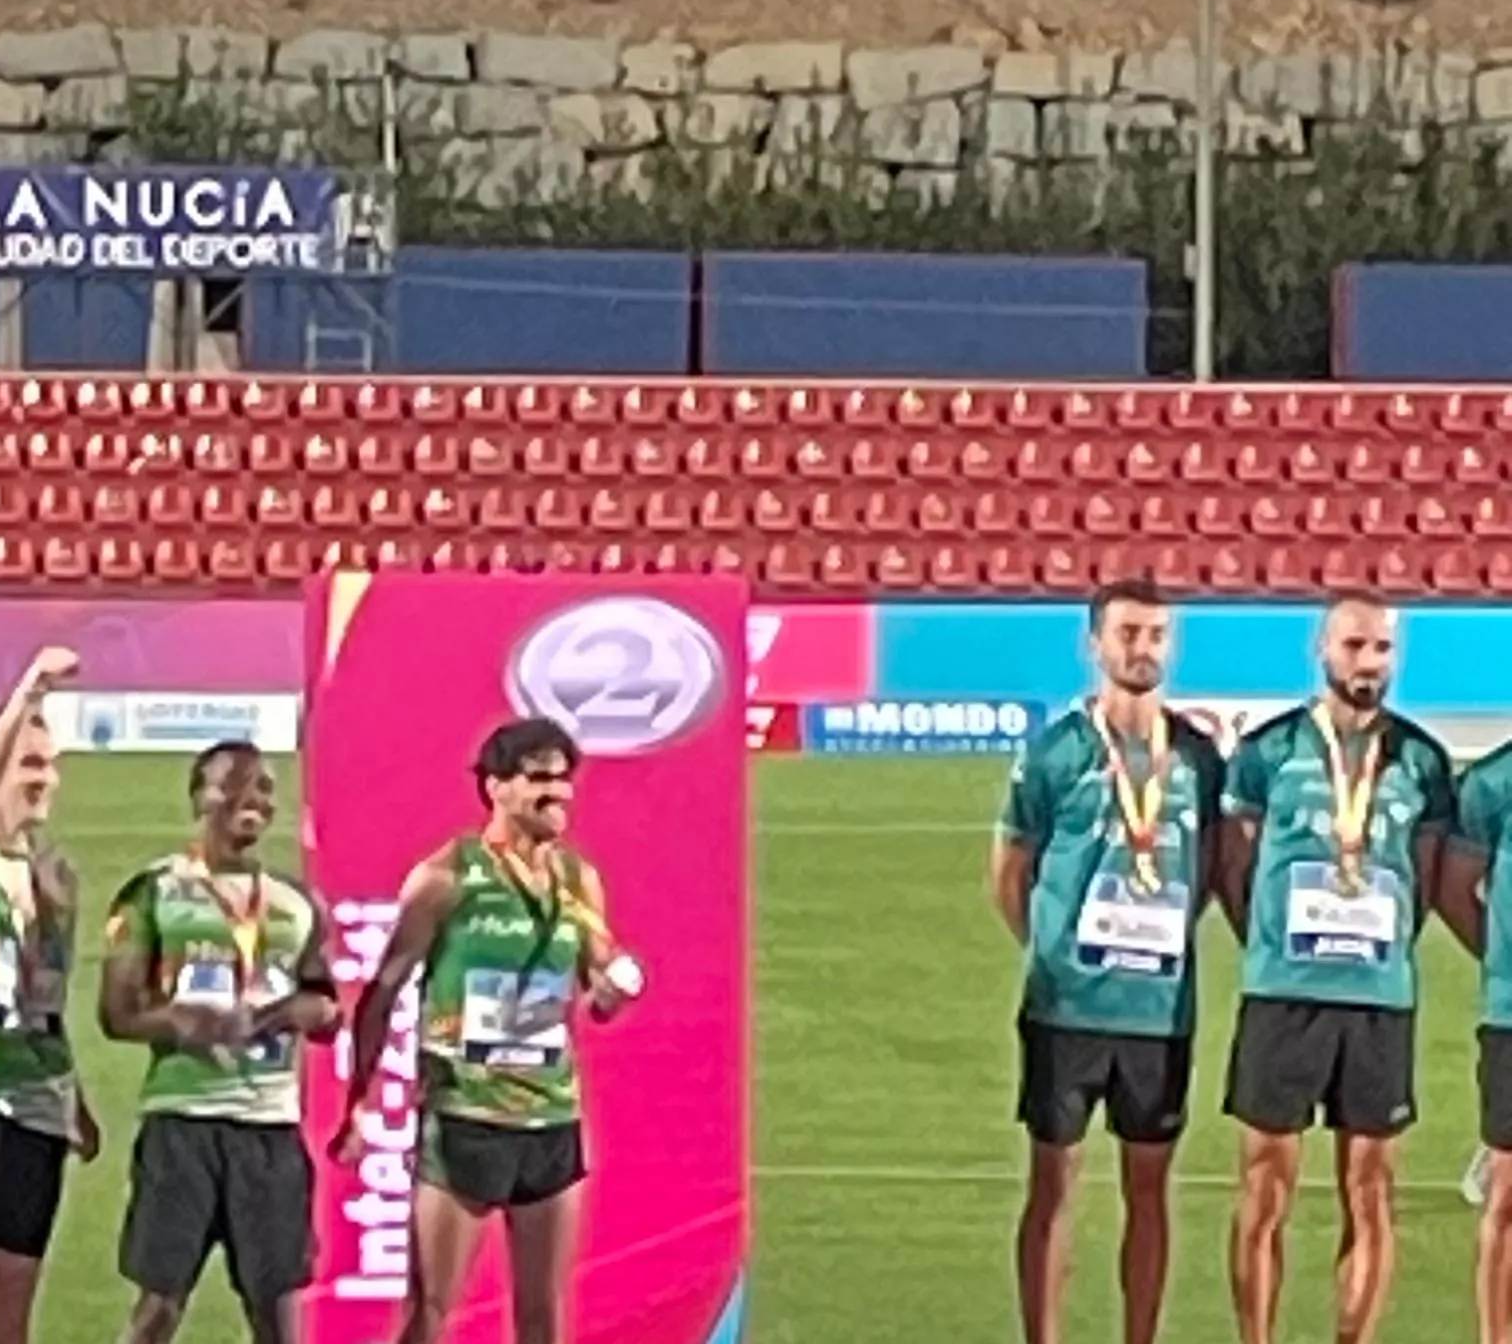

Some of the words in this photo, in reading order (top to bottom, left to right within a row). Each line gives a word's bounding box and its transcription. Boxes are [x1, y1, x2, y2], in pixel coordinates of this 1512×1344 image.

[91, 233, 155, 268] DEL
[161, 233, 319, 269] DEPORTE
[573, 628, 660, 717] 2
[856, 702, 1028, 736] MONDO
